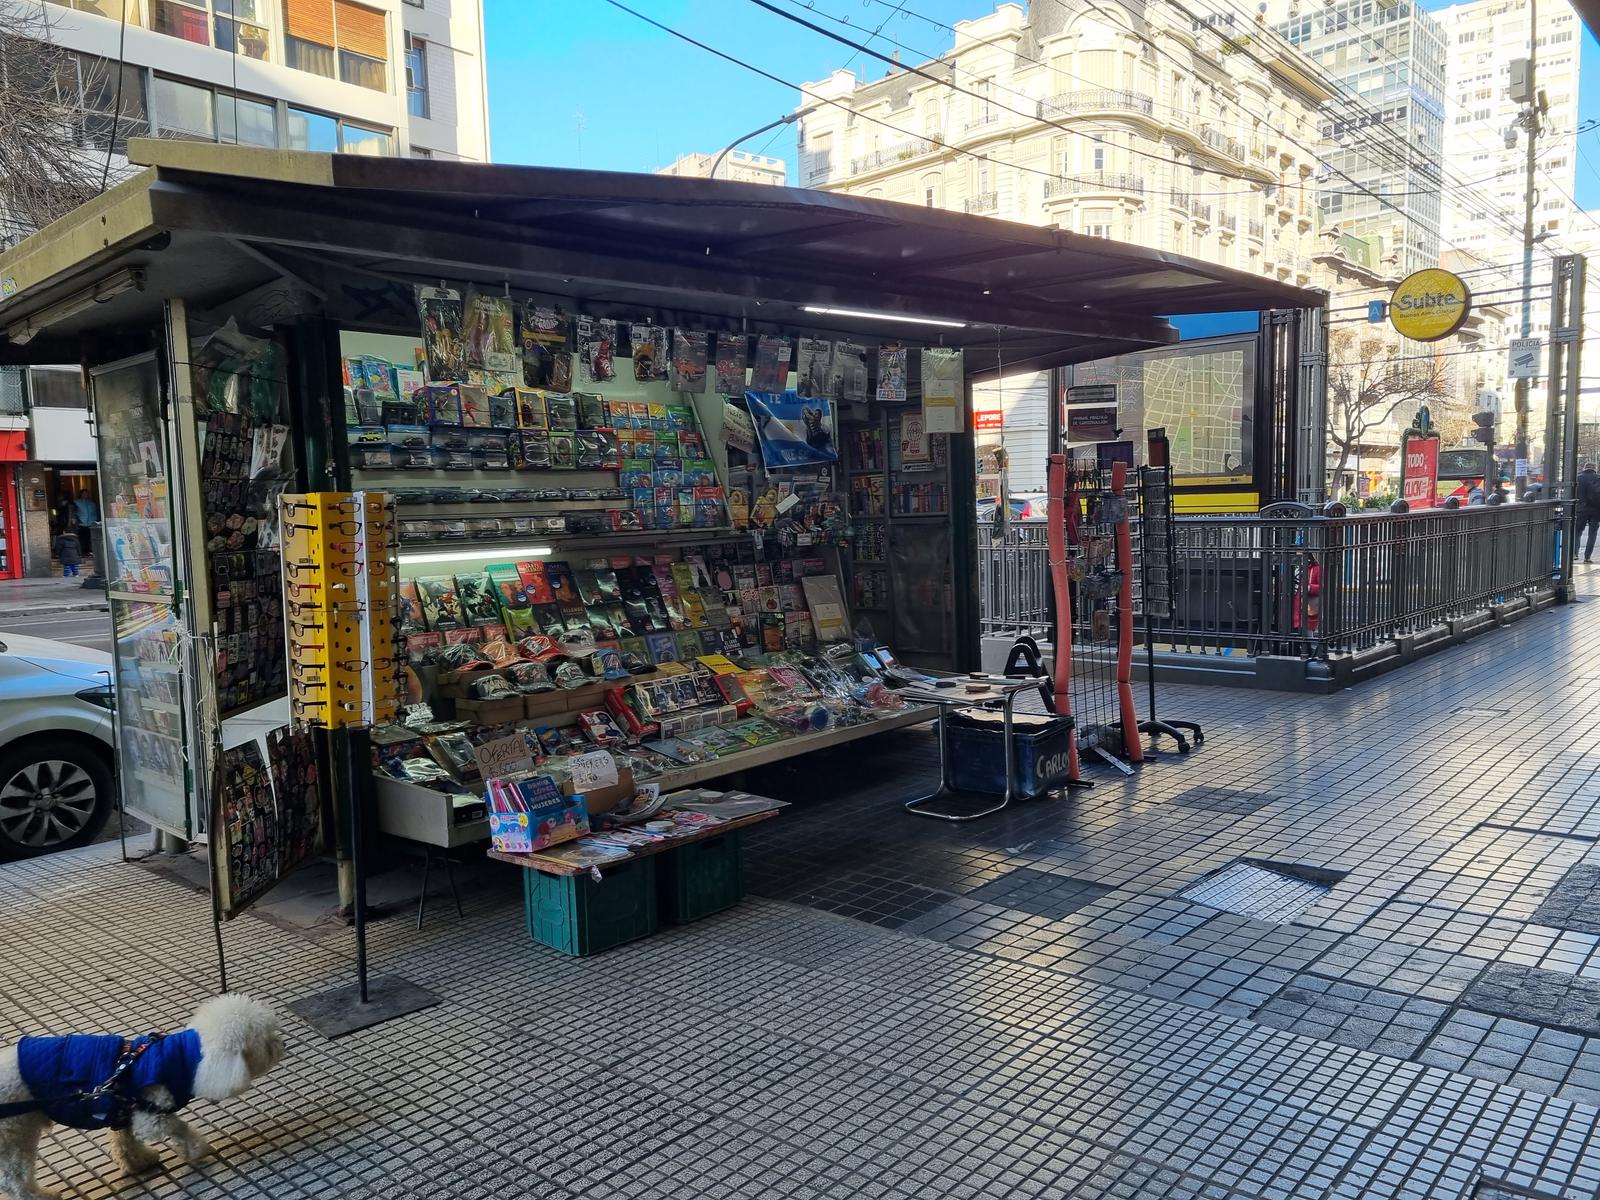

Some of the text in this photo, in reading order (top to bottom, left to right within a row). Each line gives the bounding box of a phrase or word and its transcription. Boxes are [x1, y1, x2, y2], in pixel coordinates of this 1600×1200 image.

[1399, 292, 1457, 310] Subte
[1370, 306, 1380, 316] A
[768, 393, 781, 404] TE
[1408, 453, 1424, 468] TODO
[1405, 480, 1422, 497] CLICK
[531, 797, 561, 810] MUJERES
